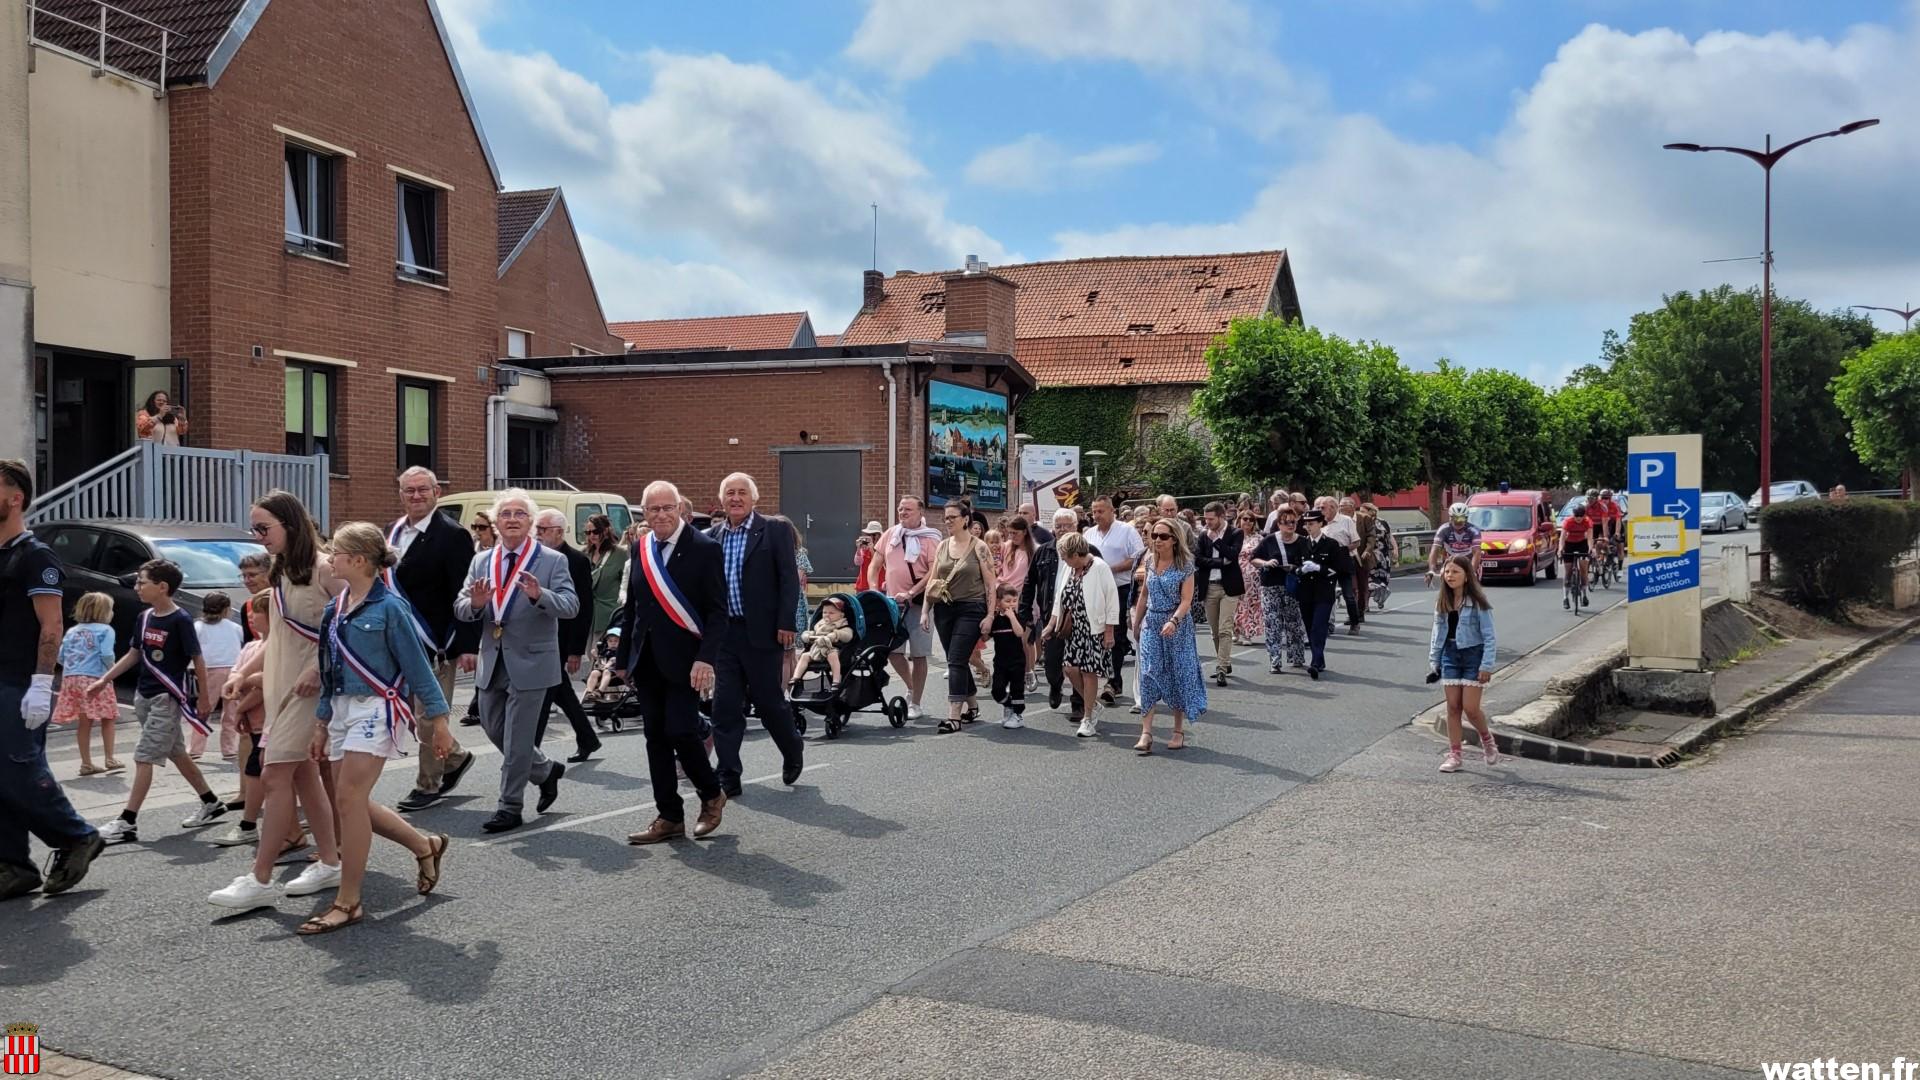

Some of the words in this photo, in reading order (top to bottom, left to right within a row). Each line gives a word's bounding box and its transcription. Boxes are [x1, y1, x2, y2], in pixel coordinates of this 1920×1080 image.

[1640, 459, 1664, 488] P
[1634, 565, 1653, 577] 100
[1655, 558, 1690, 572] Places
[1647, 574, 1654, 583] à
[1655, 570, 1680, 581] votre
[1643, 577, 1691, 594] disposition
